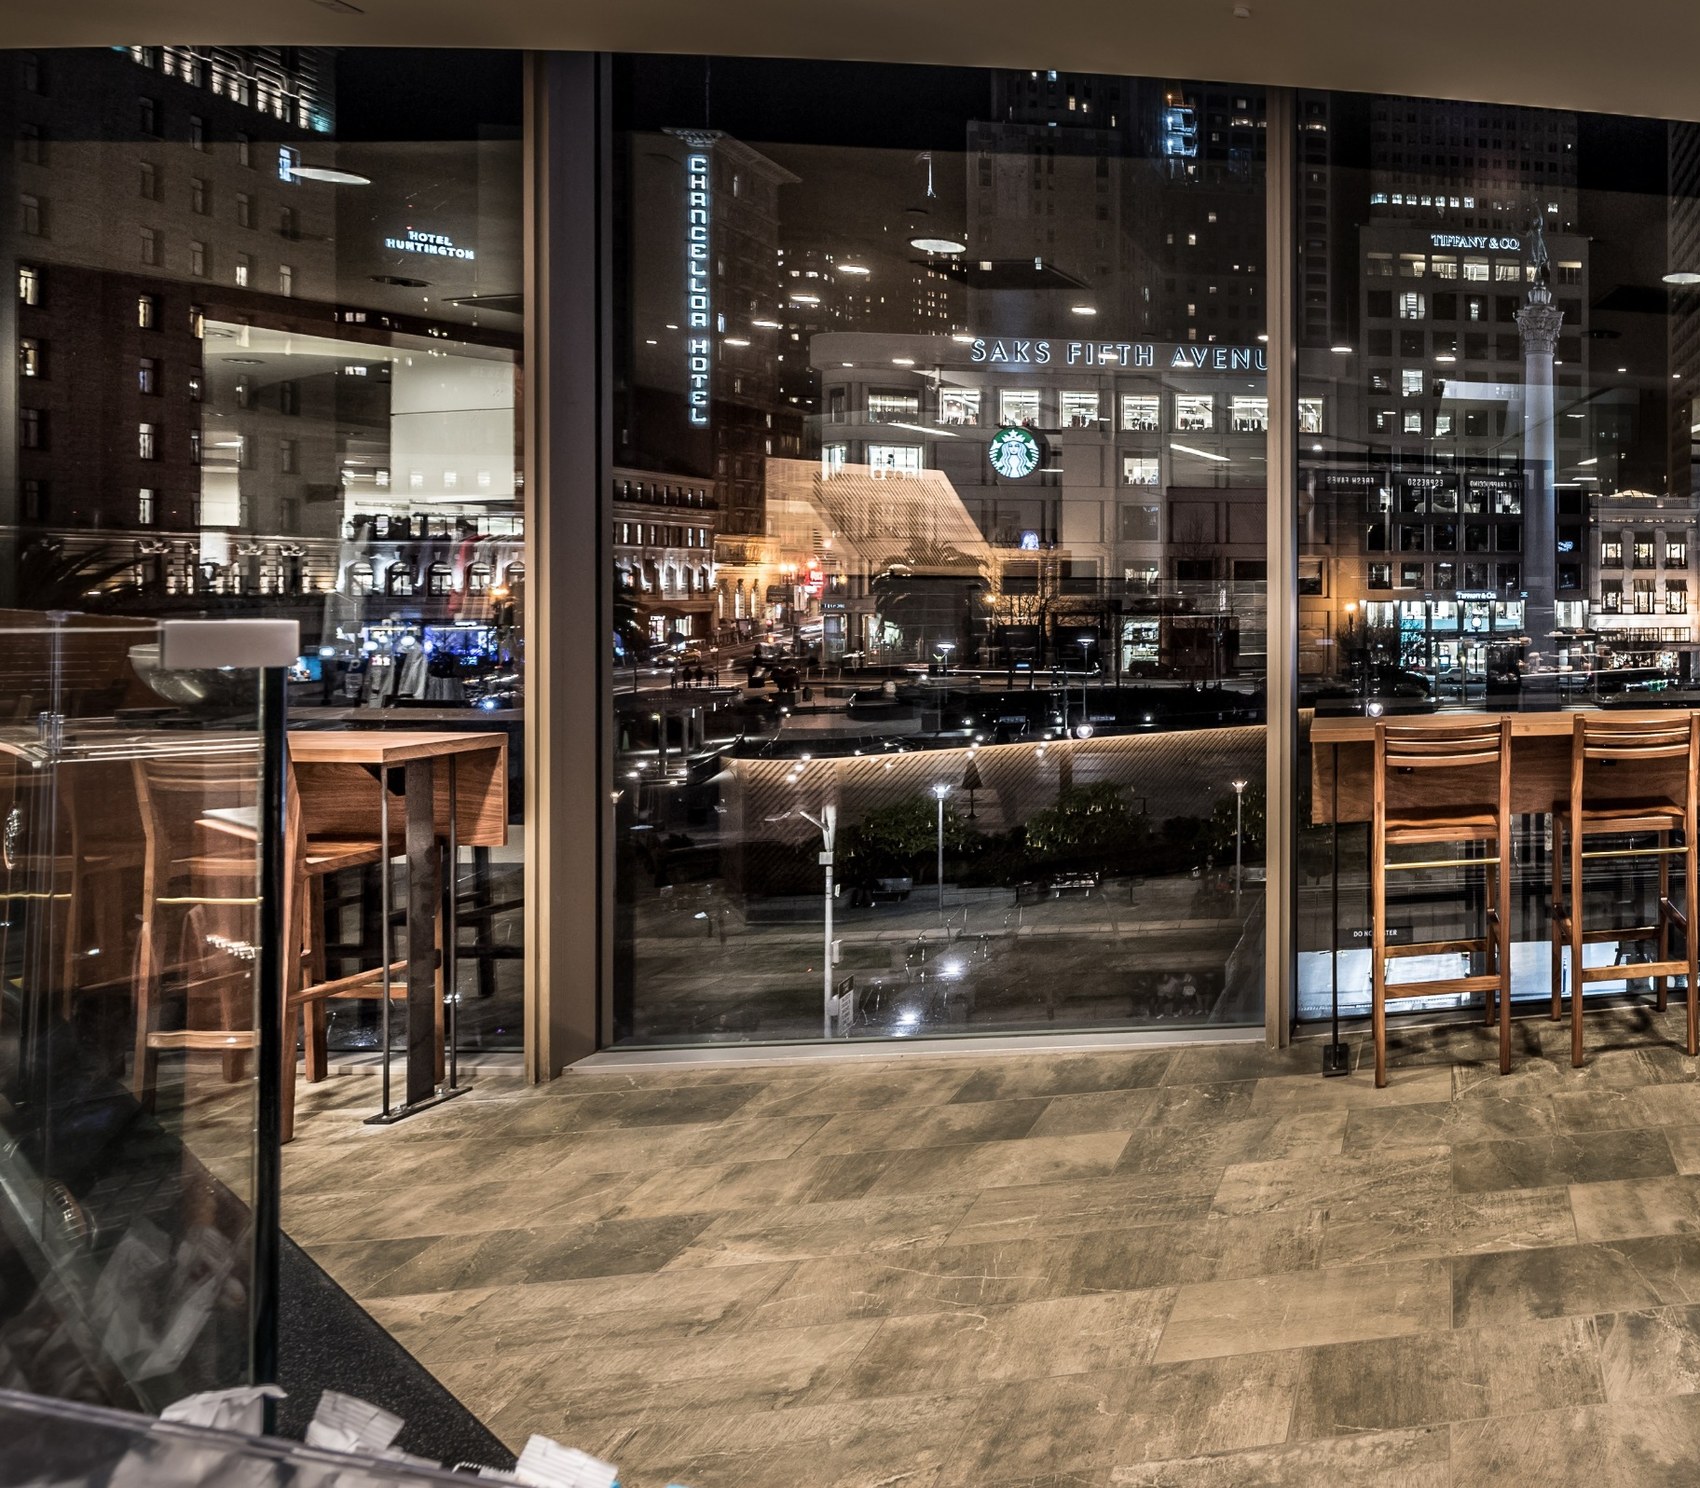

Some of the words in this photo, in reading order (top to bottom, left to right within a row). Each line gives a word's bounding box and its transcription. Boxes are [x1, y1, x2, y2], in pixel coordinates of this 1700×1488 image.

[384, 238, 475, 260] HUNTINGTON
[408, 231, 453, 247] HOTEL
[689, 156, 708, 328] CHANCELLOR
[1430, 234, 1488, 249] TIFFANY
[1488, 237, 1499, 250] &
[970, 338, 1051, 364] SAKS
[1066, 342, 1154, 367] FIFTH
[690, 339, 708, 423] HOTEL
[1353, 930, 1363, 938] DO
